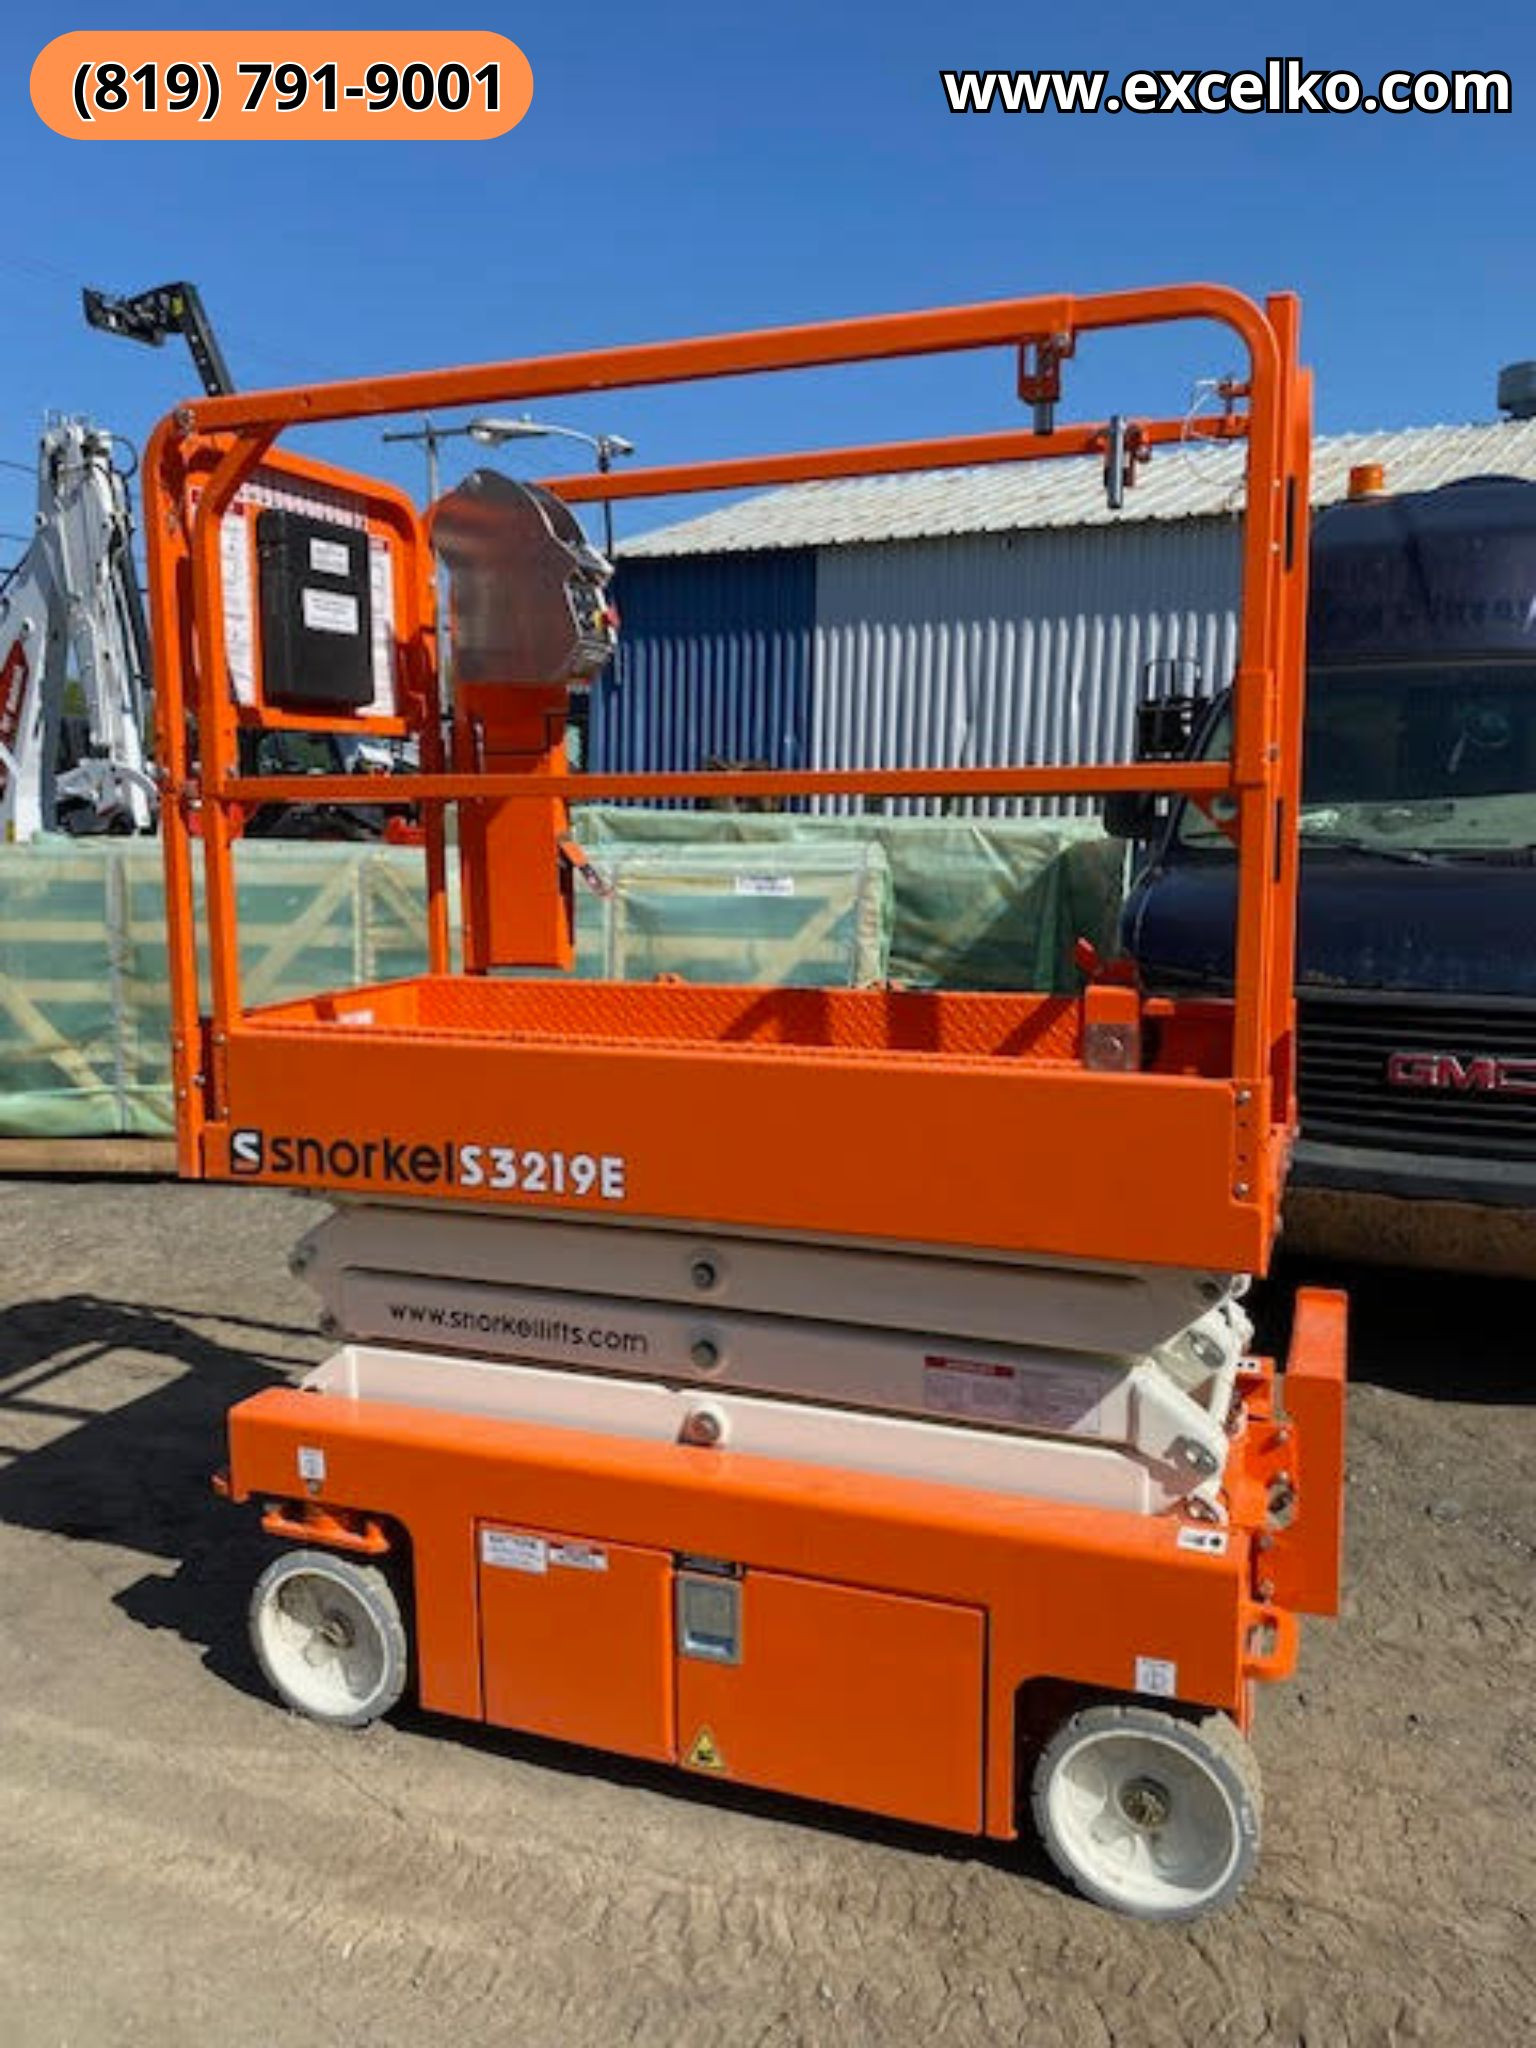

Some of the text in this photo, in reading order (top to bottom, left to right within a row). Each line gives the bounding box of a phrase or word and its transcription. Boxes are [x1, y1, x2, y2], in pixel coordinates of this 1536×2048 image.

[1388, 1053, 1536, 1095] GMC
[271, 1137, 457, 1186] snorkel
[459, 1145, 626, 1199] S3219E
[388, 1303, 648, 1354] www.snorkellifts.com
